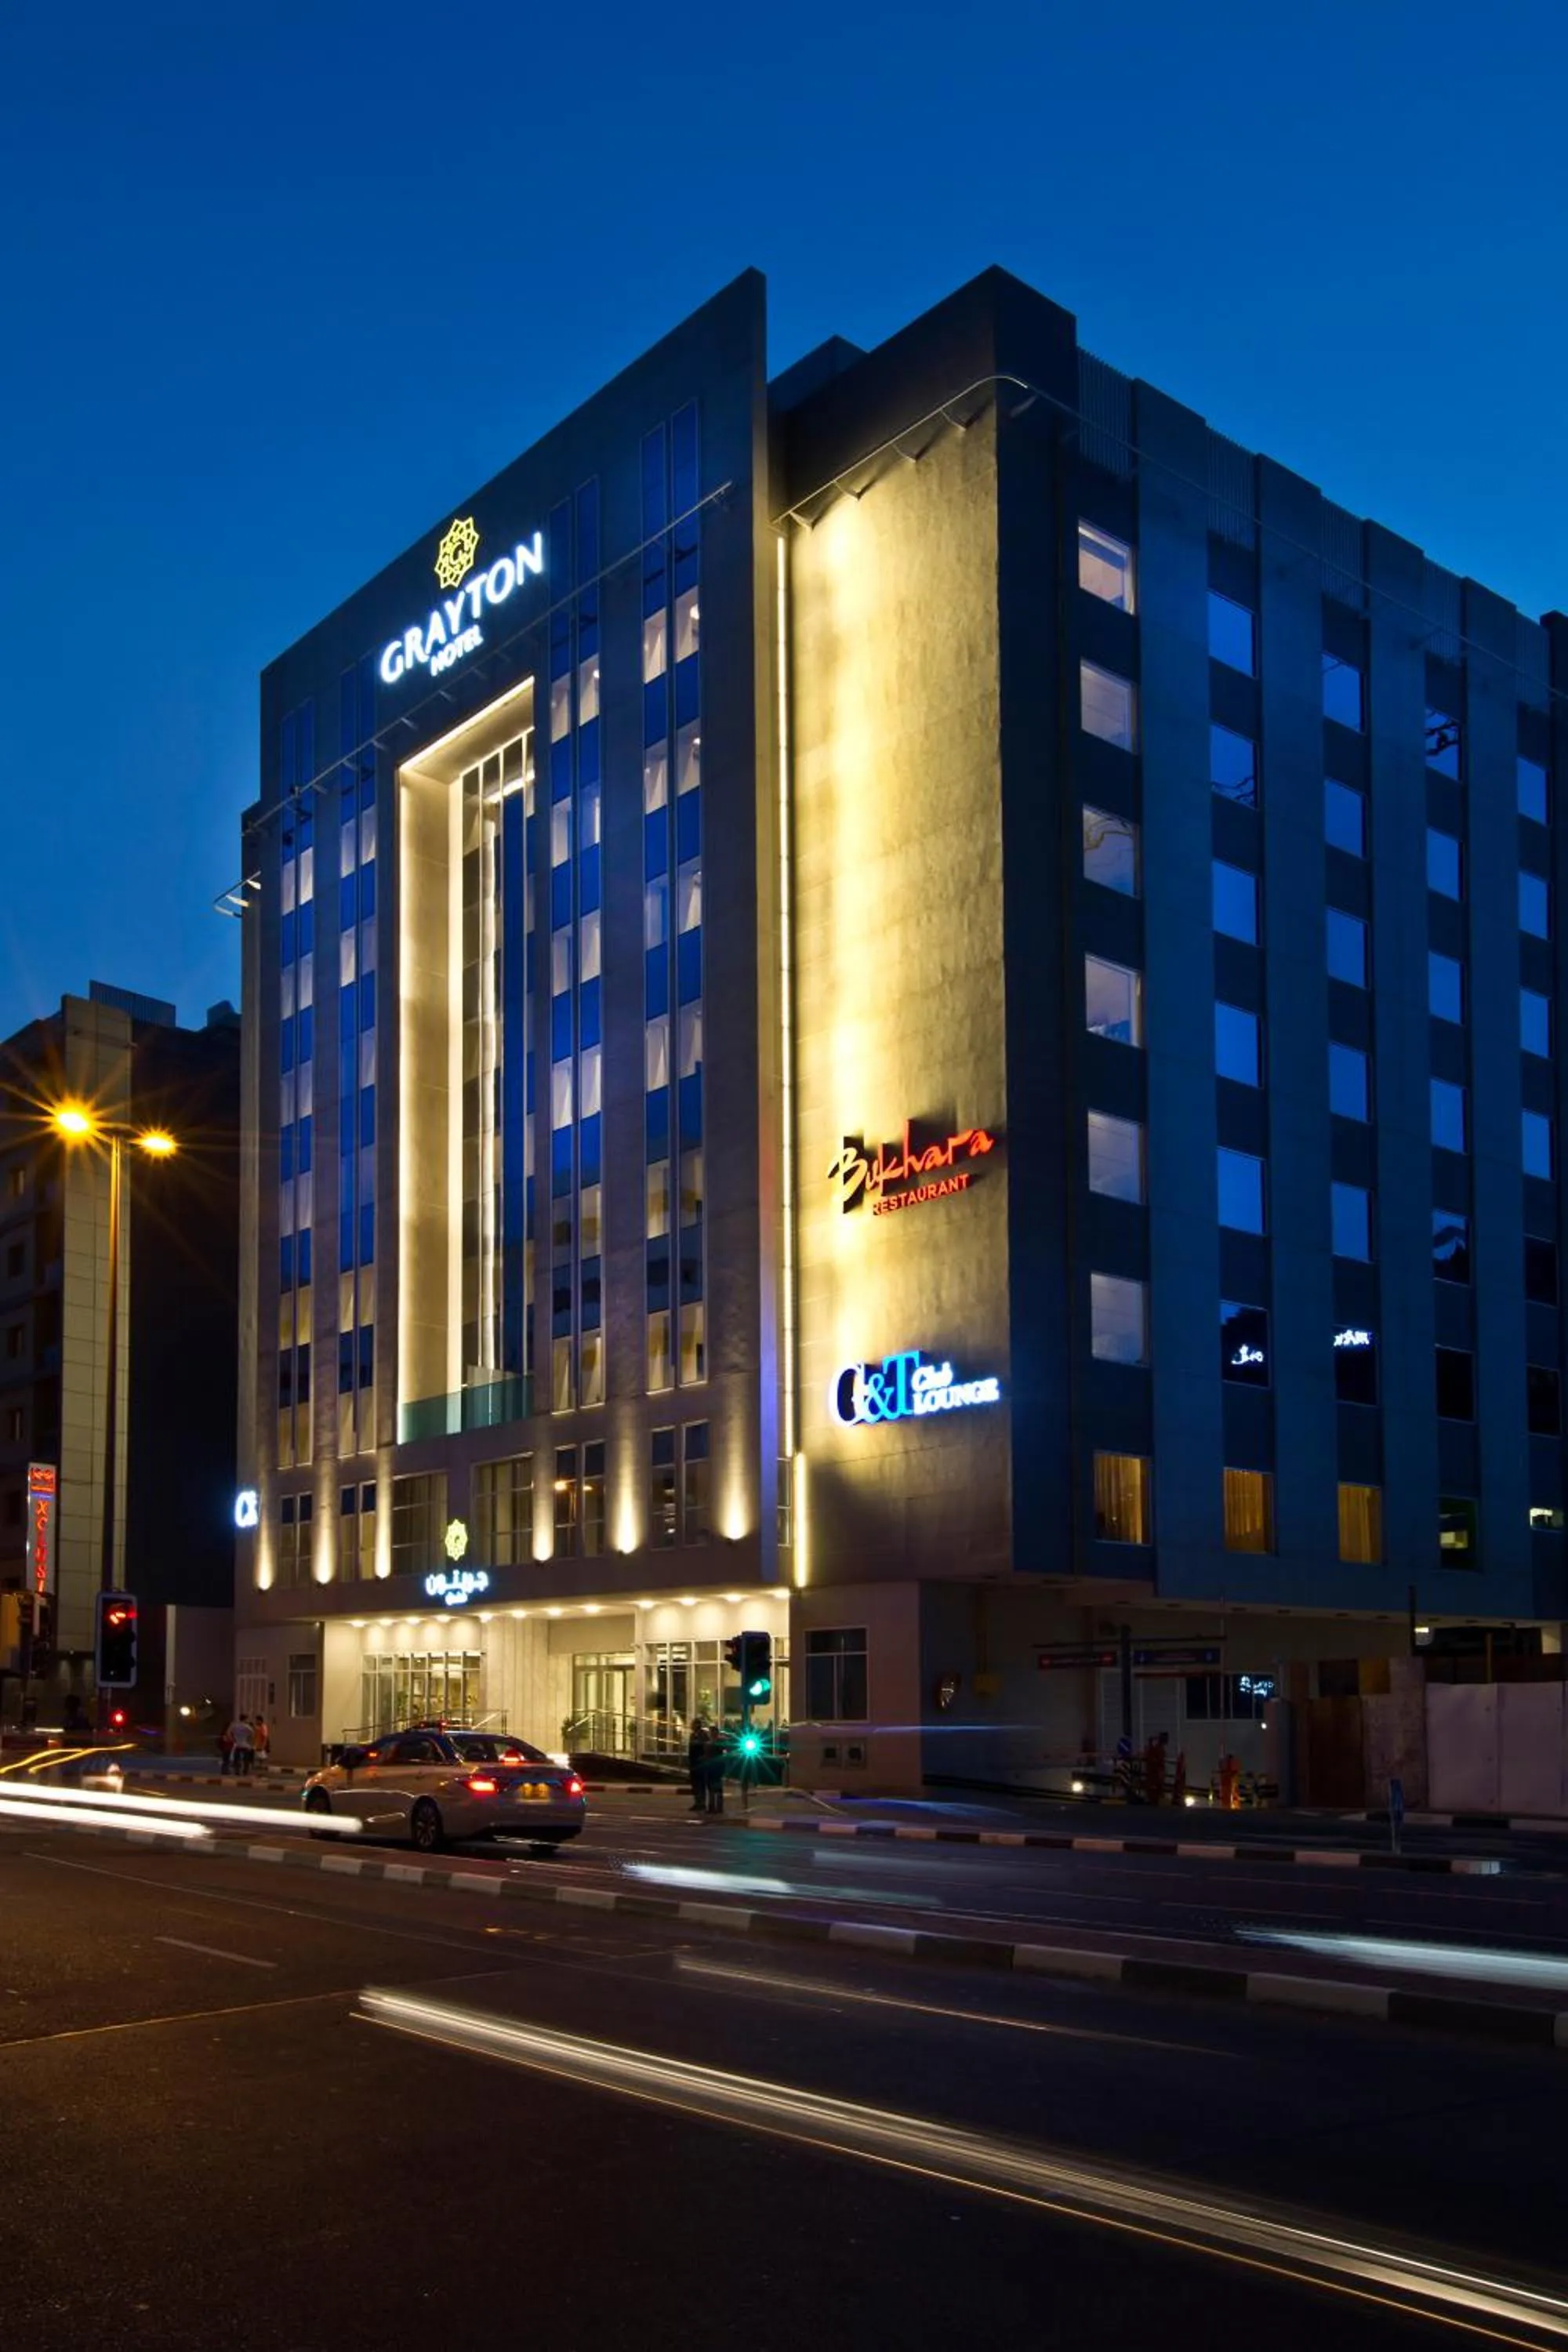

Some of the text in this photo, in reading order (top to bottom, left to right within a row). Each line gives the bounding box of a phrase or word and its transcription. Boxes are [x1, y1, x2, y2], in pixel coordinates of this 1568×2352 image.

[380, 532, 543, 682] GRAYTON
[430, 624, 484, 677] HOTEL
[828, 1119, 995, 1203] Bukhara
[873, 1173, 970, 1215] RESTAURANT
